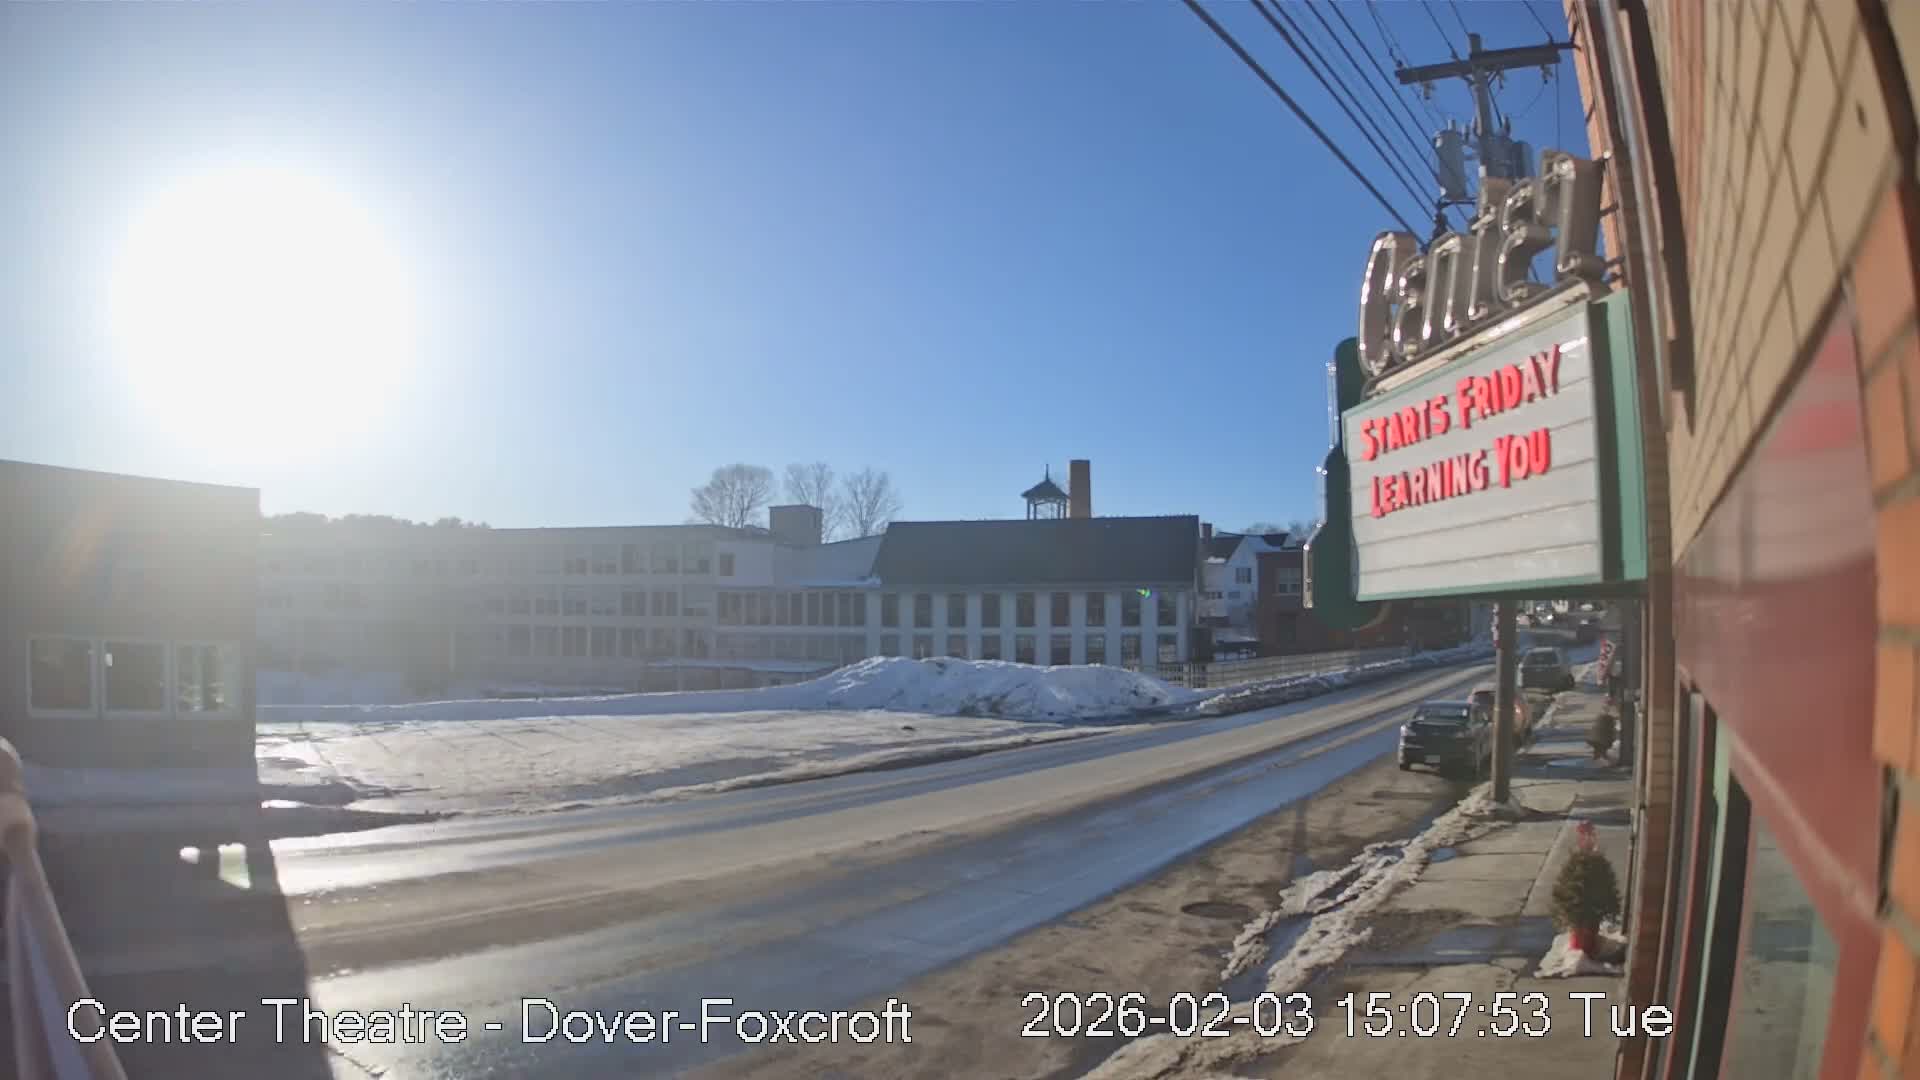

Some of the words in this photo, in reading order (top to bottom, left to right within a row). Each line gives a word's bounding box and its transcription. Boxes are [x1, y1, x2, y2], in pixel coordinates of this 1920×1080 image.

[1360, 393, 1450, 462] STARTS
[1456, 343, 1561, 430] FRIDAY
[1371, 449, 1490, 519] LEARNING
[1493, 427, 1551, 489] YOU
